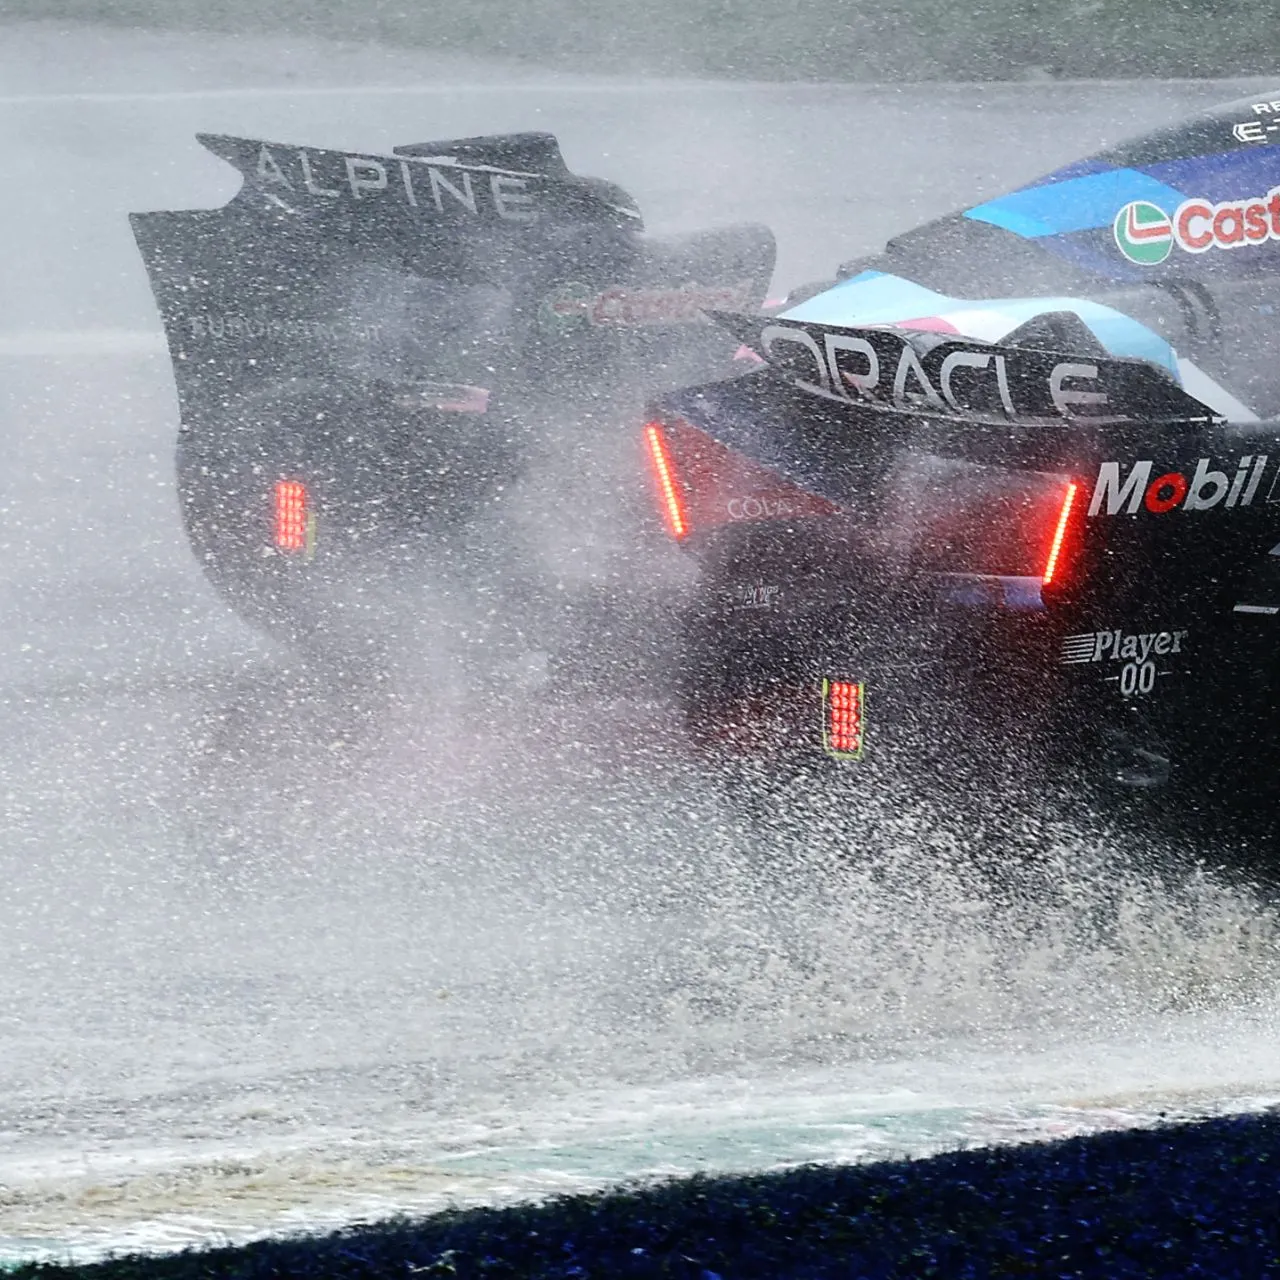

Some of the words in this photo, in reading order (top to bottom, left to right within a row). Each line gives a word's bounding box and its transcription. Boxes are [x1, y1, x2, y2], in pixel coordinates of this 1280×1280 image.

[255, 142, 541, 221] ALPINE
[761, 324, 1108, 423] ORACLE
[1087, 454, 1269, 517] Mobil
[1090, 629, 1189, 666] Player
